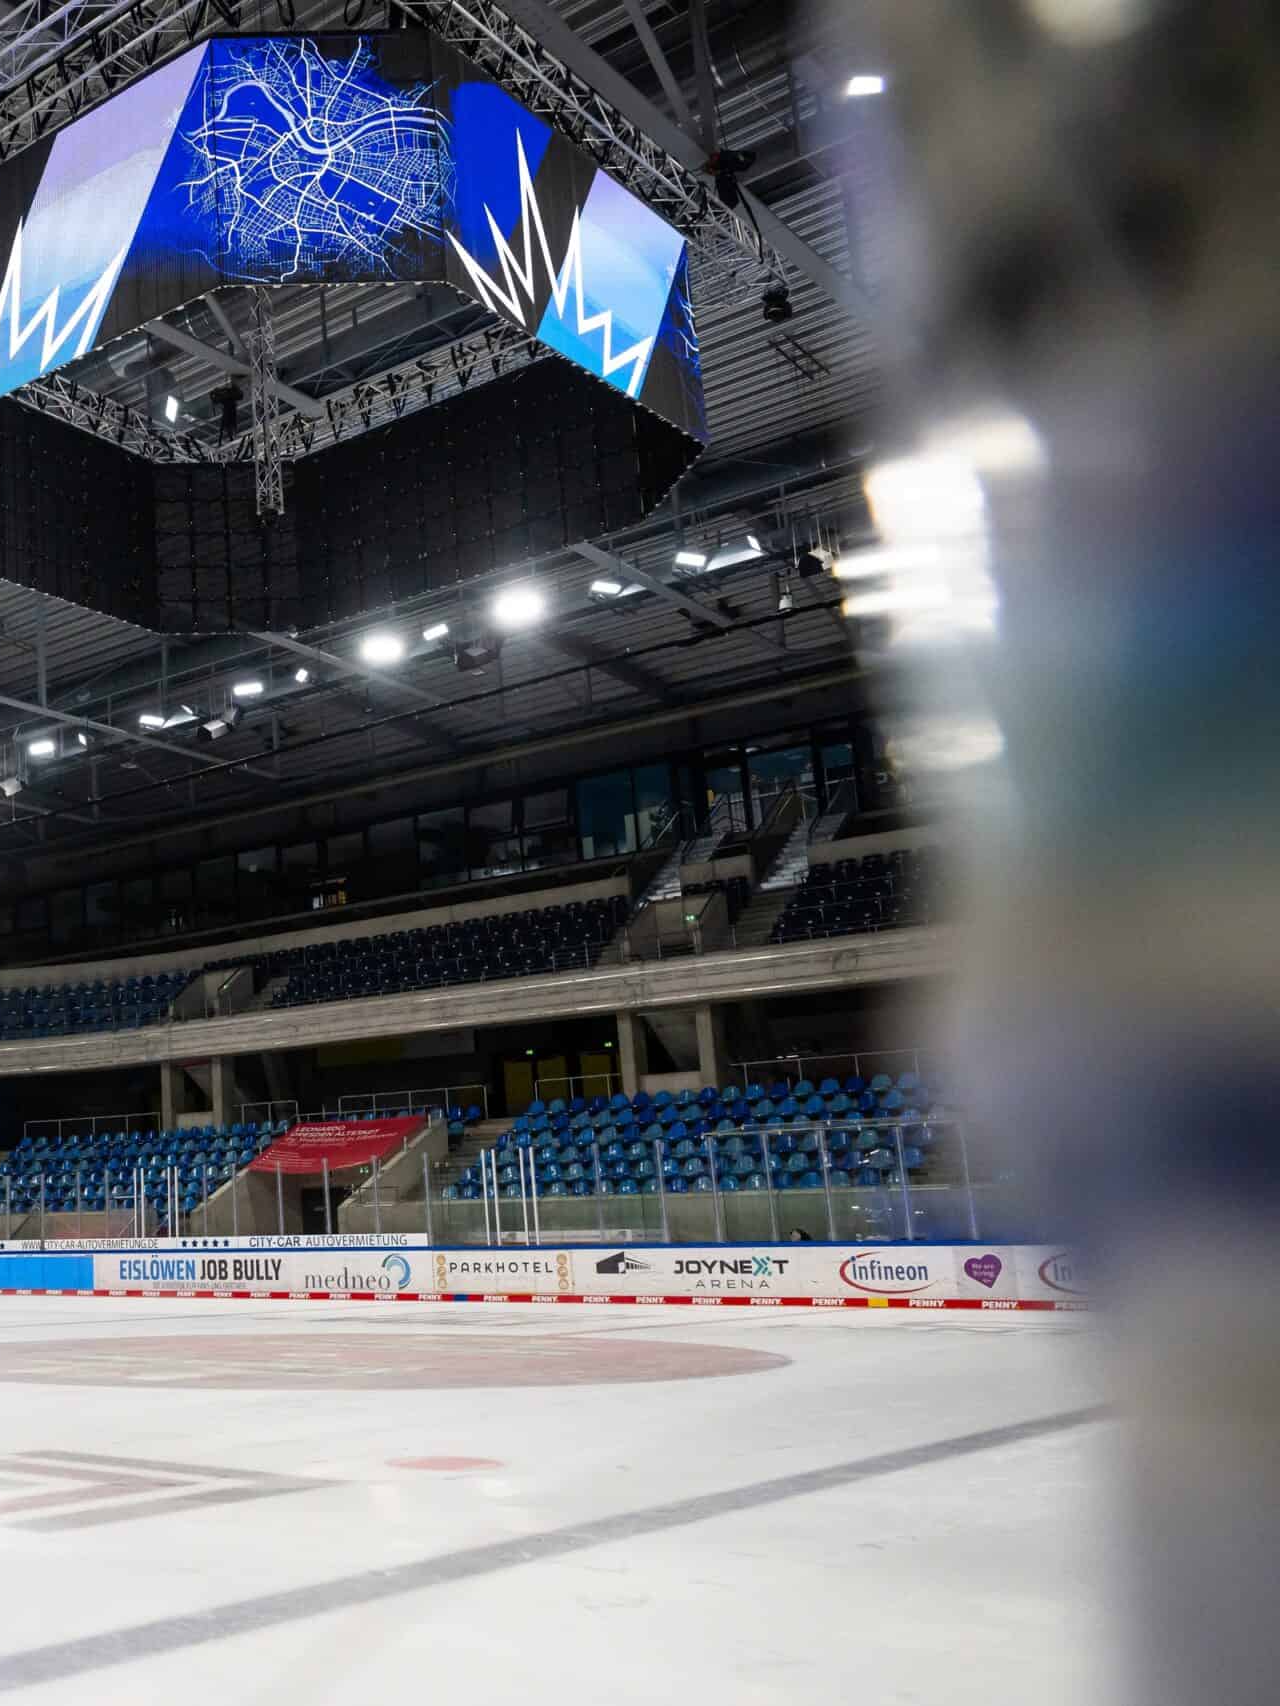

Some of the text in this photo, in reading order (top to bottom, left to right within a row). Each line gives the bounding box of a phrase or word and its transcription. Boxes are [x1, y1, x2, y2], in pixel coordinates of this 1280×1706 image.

[248, 1234, 408, 1247] CITY-CAR AUTOVERMIETUNG
[119, 1254, 282, 1280] EISLÖWEN JOB BULLY
[449, 1262, 553, 1273] PARKHOTEL
[674, 1257, 789, 1276] JOYNEXT
[305, 1267, 391, 1290] medneo
[696, 1280, 770, 1289] ARENA
